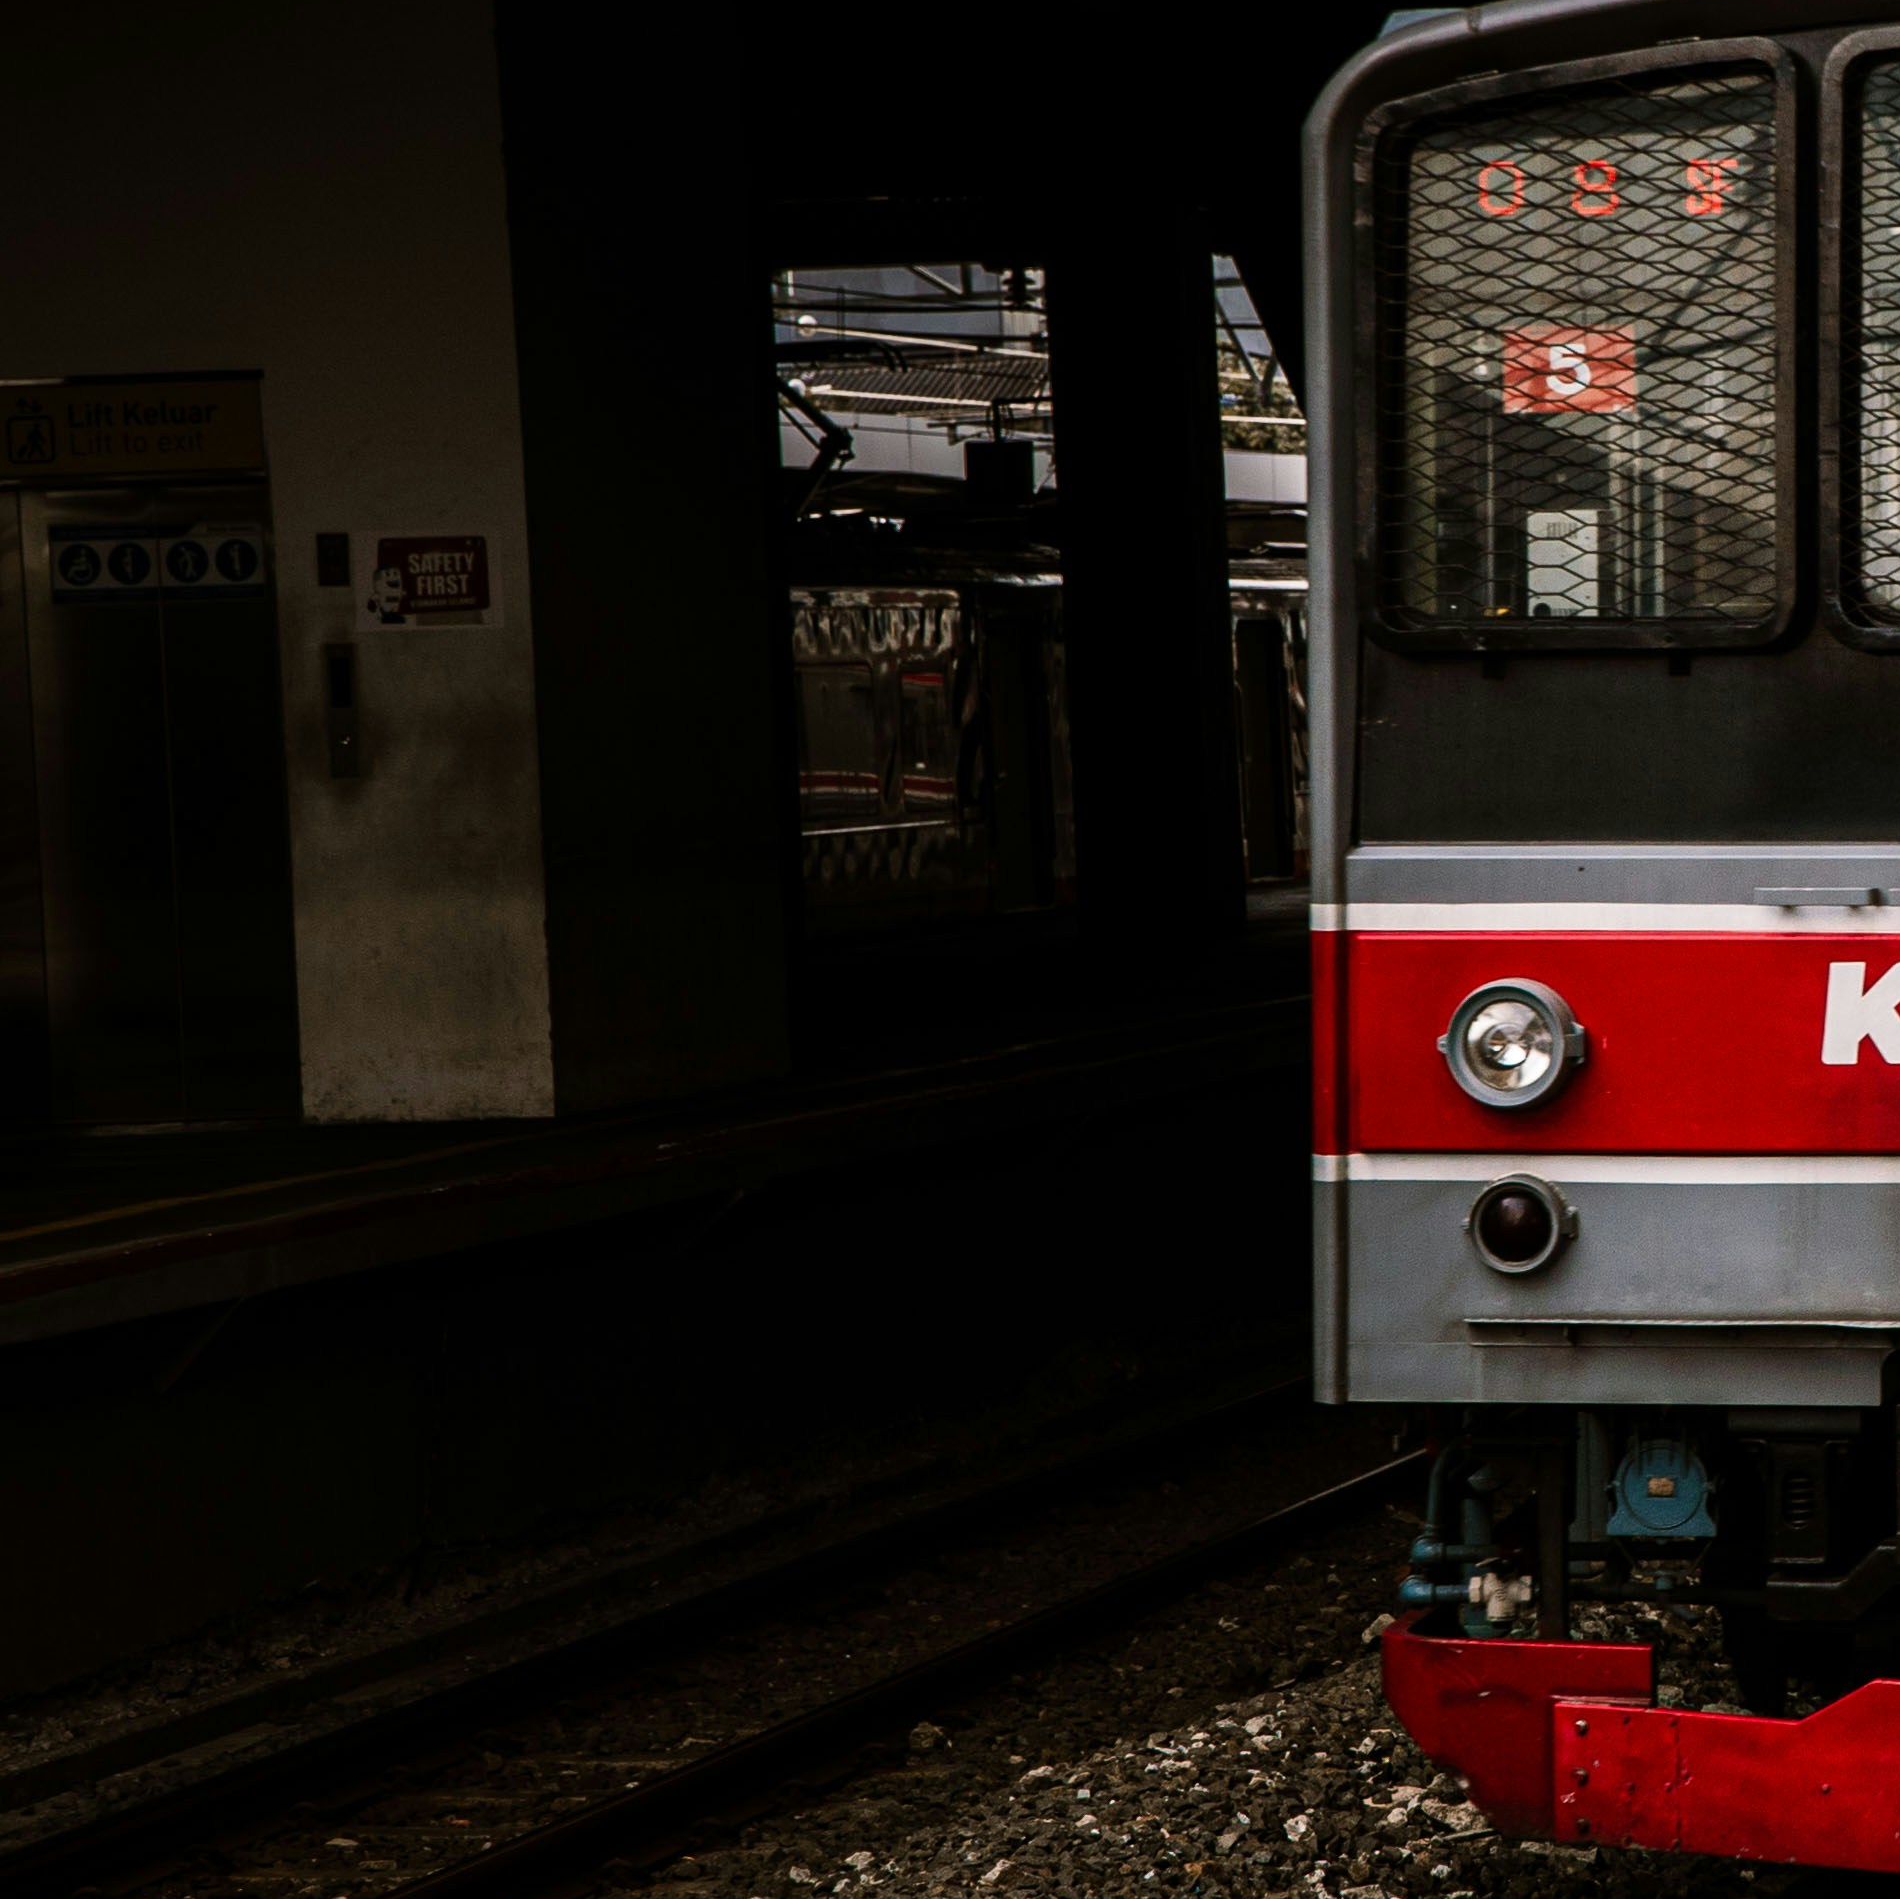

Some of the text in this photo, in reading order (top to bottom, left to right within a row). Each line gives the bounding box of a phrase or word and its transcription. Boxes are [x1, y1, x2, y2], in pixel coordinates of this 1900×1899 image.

[1545, 343, 1592, 395] 5
[66, 400, 218, 429] Lift Keluar
[69, 431, 206, 456] Lift to exit
[407, 550, 476, 574] SAFETY
[415, 573, 470, 597] FIRST
